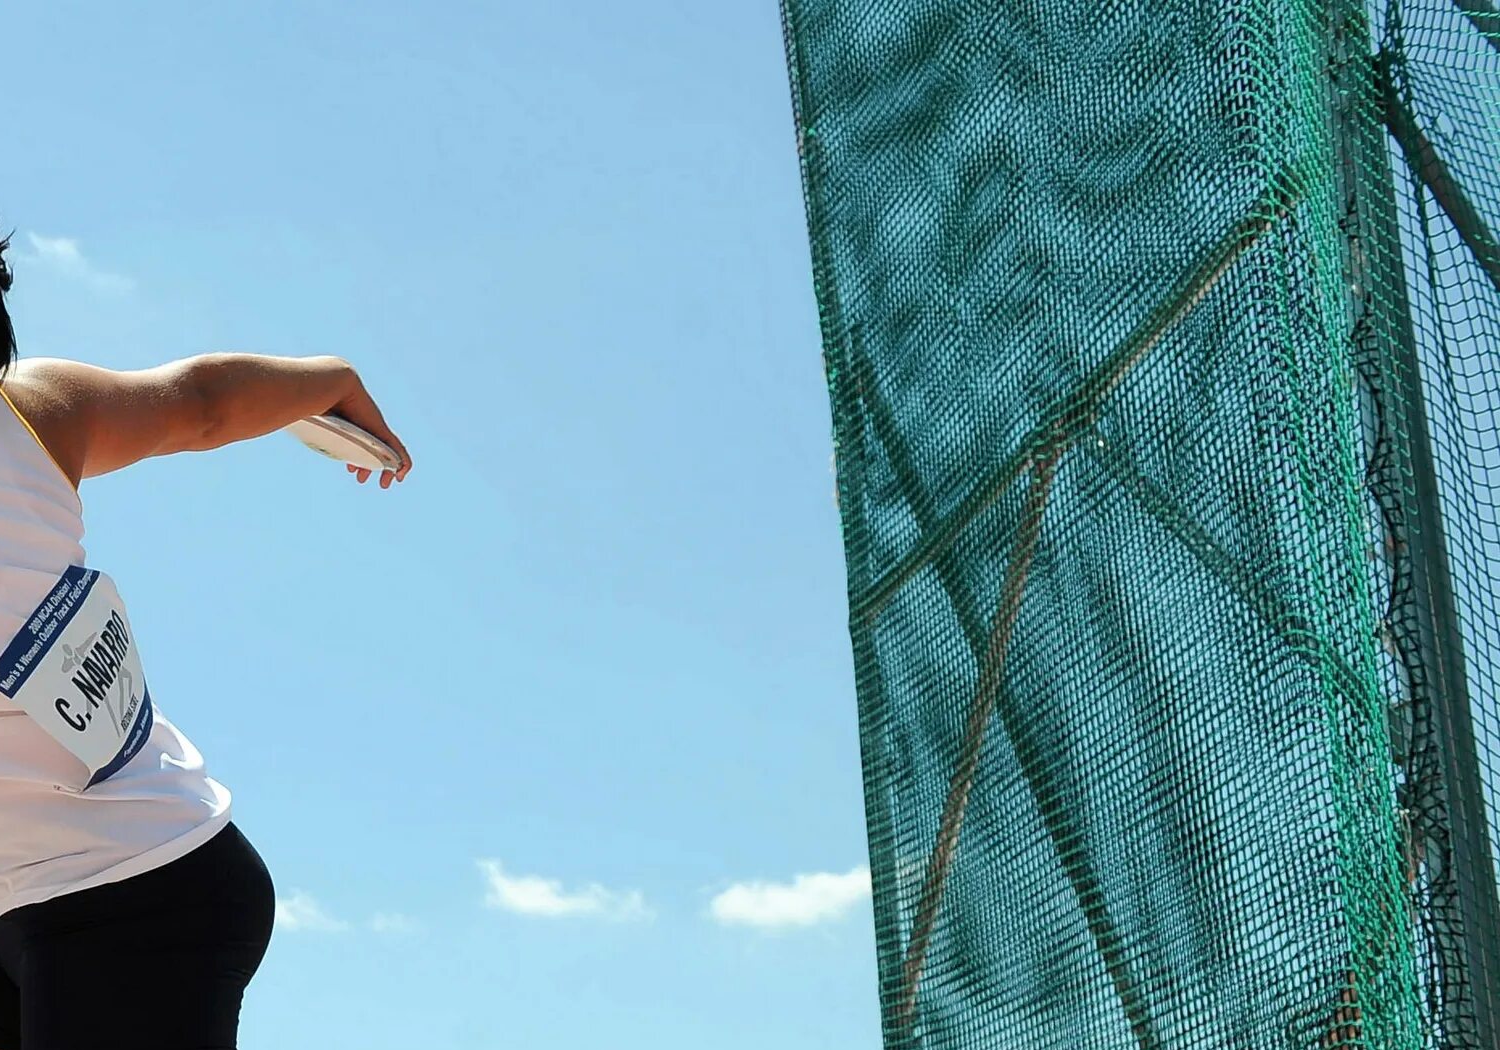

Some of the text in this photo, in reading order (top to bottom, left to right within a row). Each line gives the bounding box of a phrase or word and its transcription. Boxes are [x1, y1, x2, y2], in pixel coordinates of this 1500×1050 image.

[38, 602, 55, 622] NCAA
[50, 583, 70, 606] Division
[65, 597, 73, 607] &
[68, 585, 81, 602] Field
[53, 603, 69, 620] Track
[38, 618, 58, 641] Outdoor
[19, 639, 43, 666] Women's
[15, 662, 25, 672] &
[55, 609, 130, 731] C. NAVARRO
[0, 669, 20, 690] Men's
